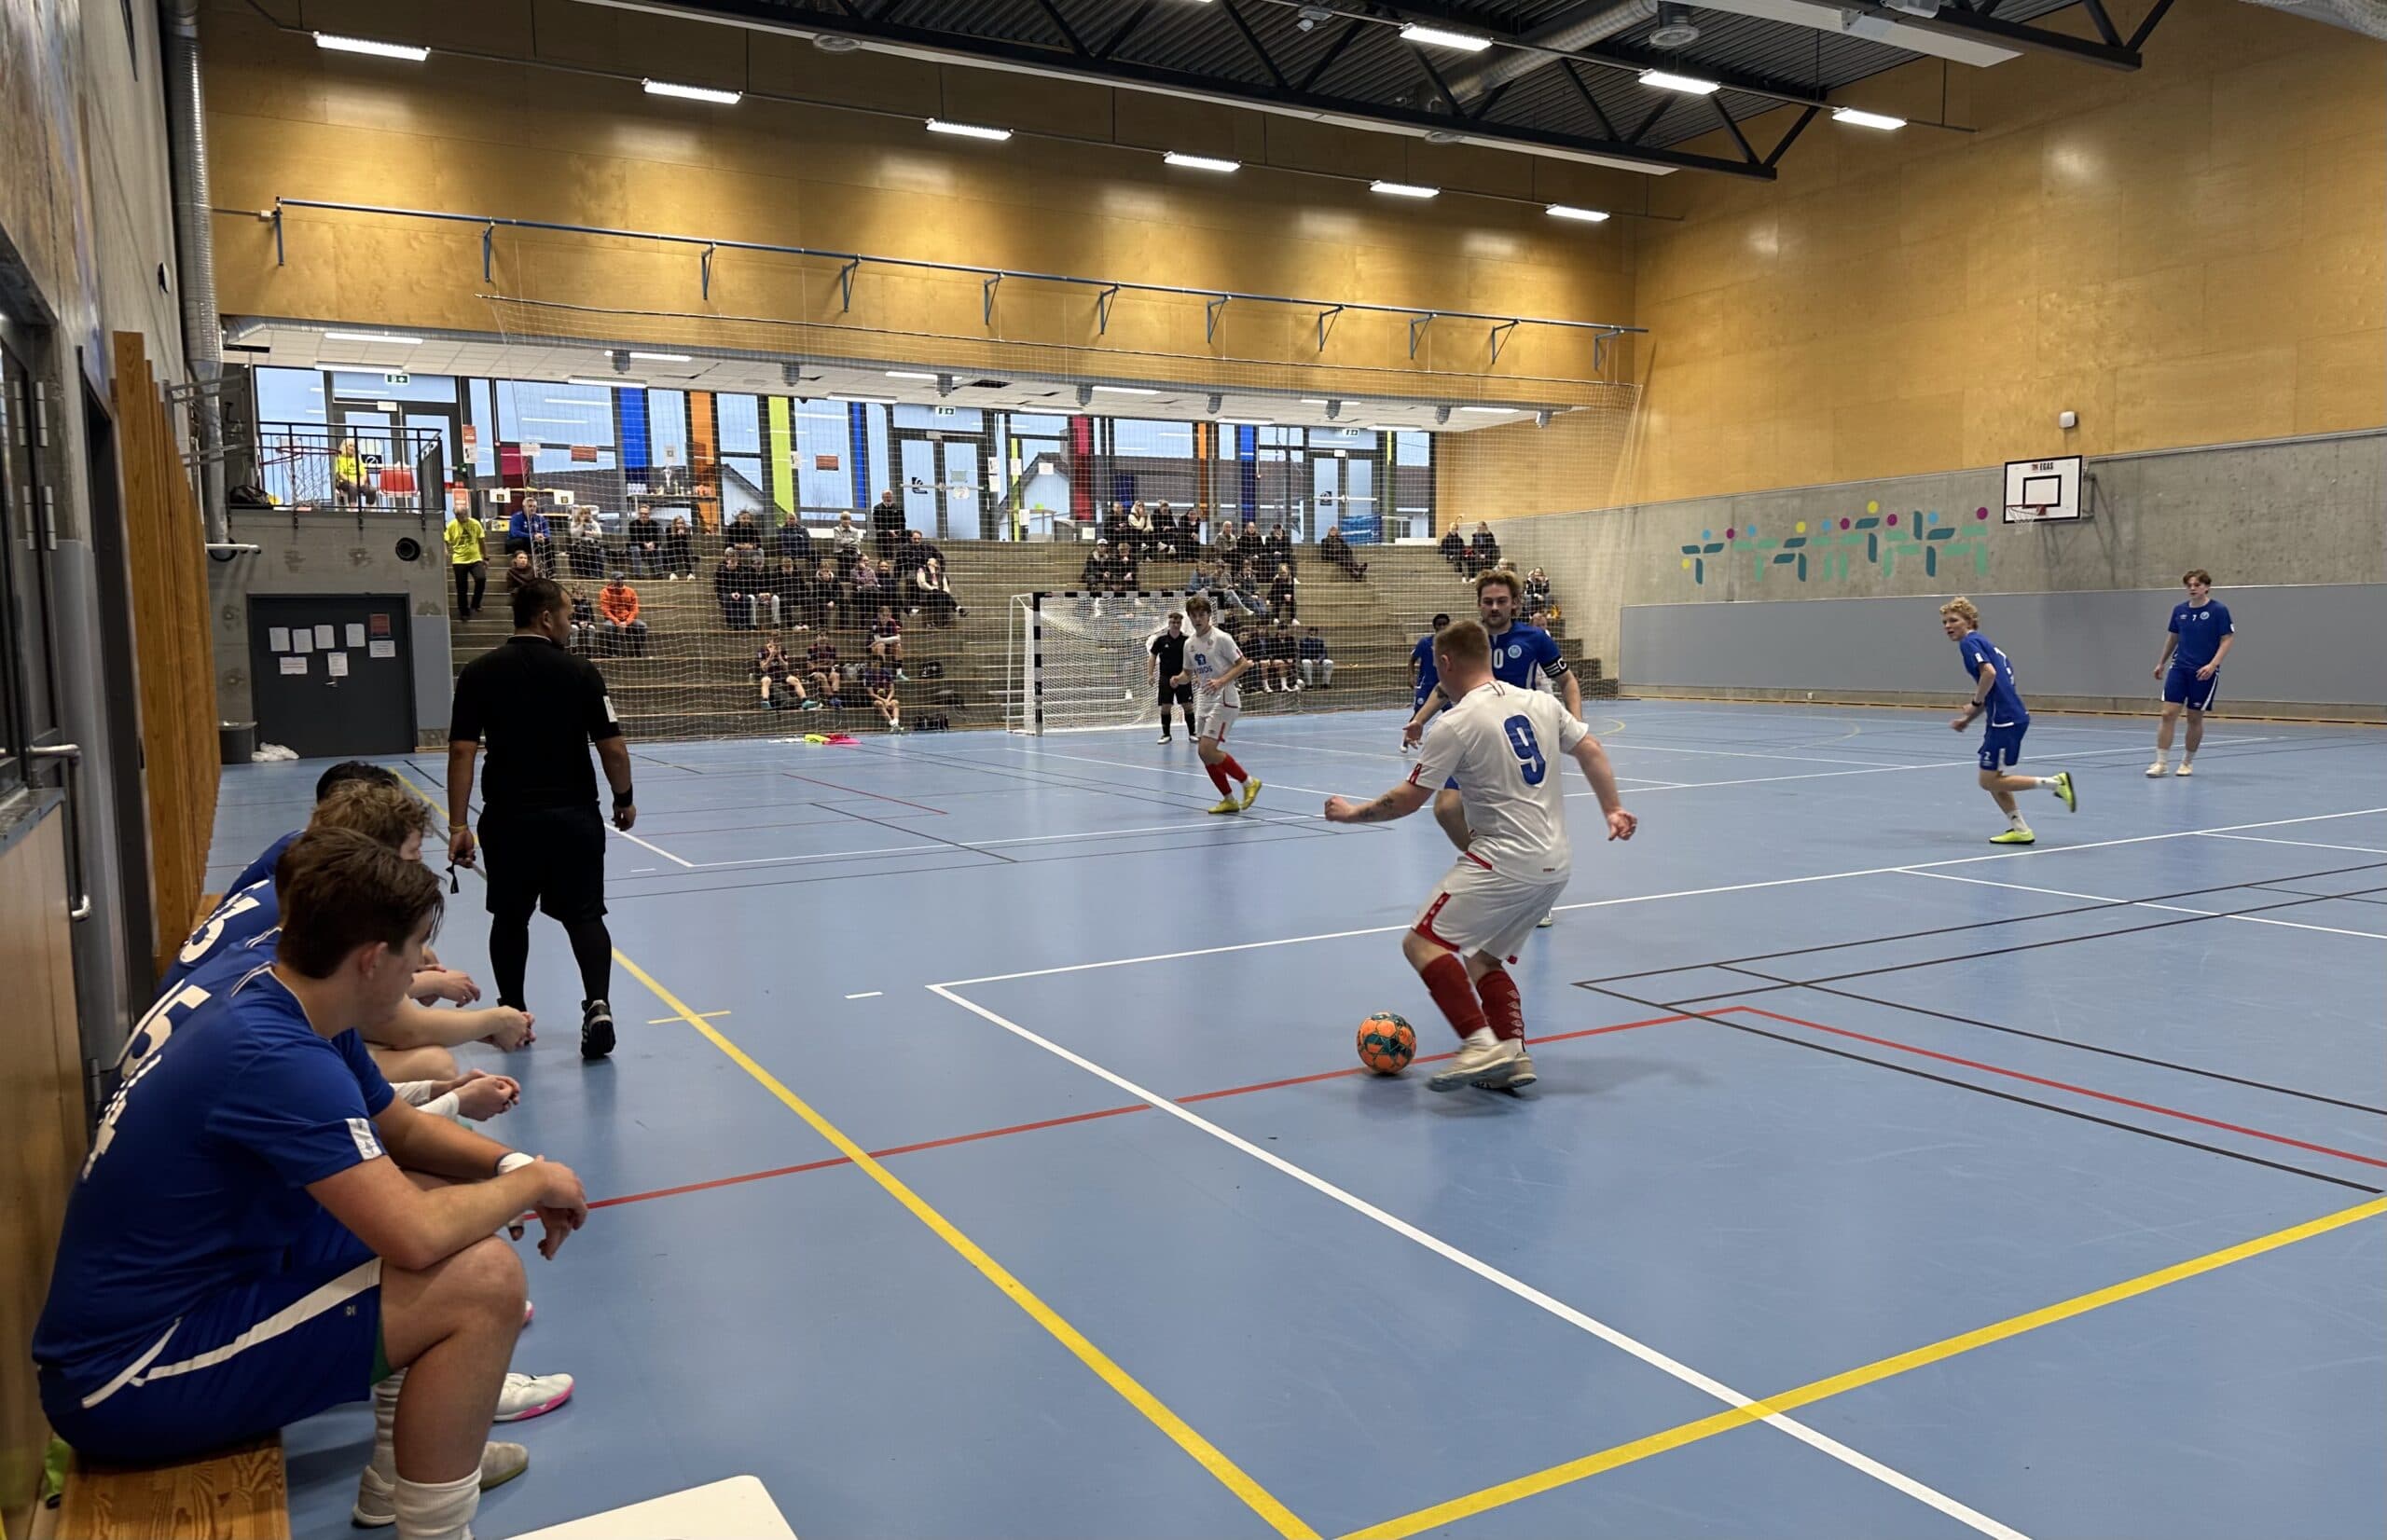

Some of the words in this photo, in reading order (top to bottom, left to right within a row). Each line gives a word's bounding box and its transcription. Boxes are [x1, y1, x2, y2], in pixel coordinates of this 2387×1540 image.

[1489, 648, 1503, 668] 0
[1557, 657, 1567, 670] C
[1502, 712, 1549, 789] 9
